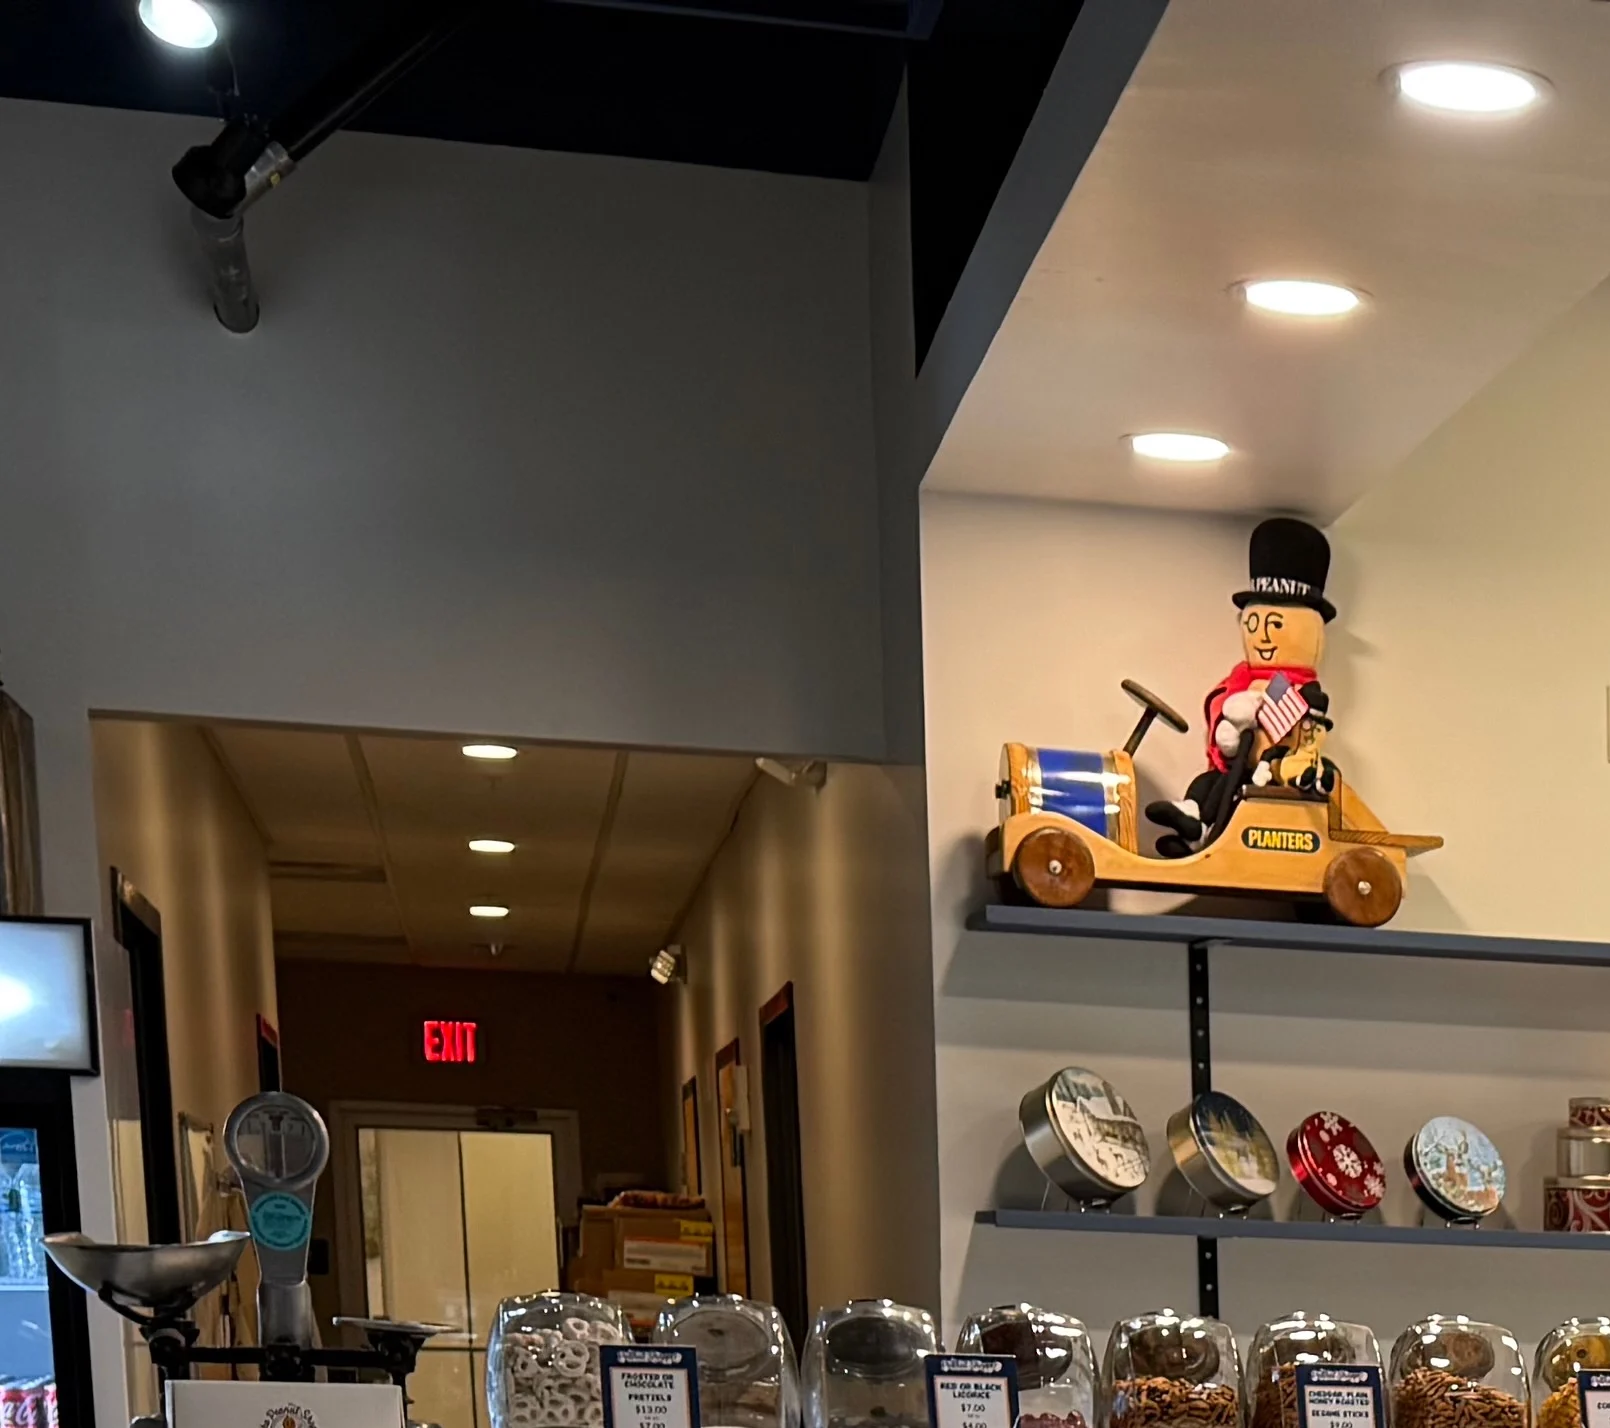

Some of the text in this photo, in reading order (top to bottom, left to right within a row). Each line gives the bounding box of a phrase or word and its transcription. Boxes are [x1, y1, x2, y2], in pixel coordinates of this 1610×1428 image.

[1247, 829, 1314, 851] PLANTERS
[423, 1020, 478, 1063] EXIT
[621, 1372, 660, 1380] FROSTED
[624, 1378, 674, 1389] CHOCOLATE
[940, 1382, 957, 1390] RED
[974, 1383, 1001, 1391] BLACK
[628, 1393, 672, 1402] PRETZELS
[953, 1391, 990, 1399] LICORICE
[635, 1405, 667, 1414] $13.00
[961, 1403, 986, 1412] $7.00
